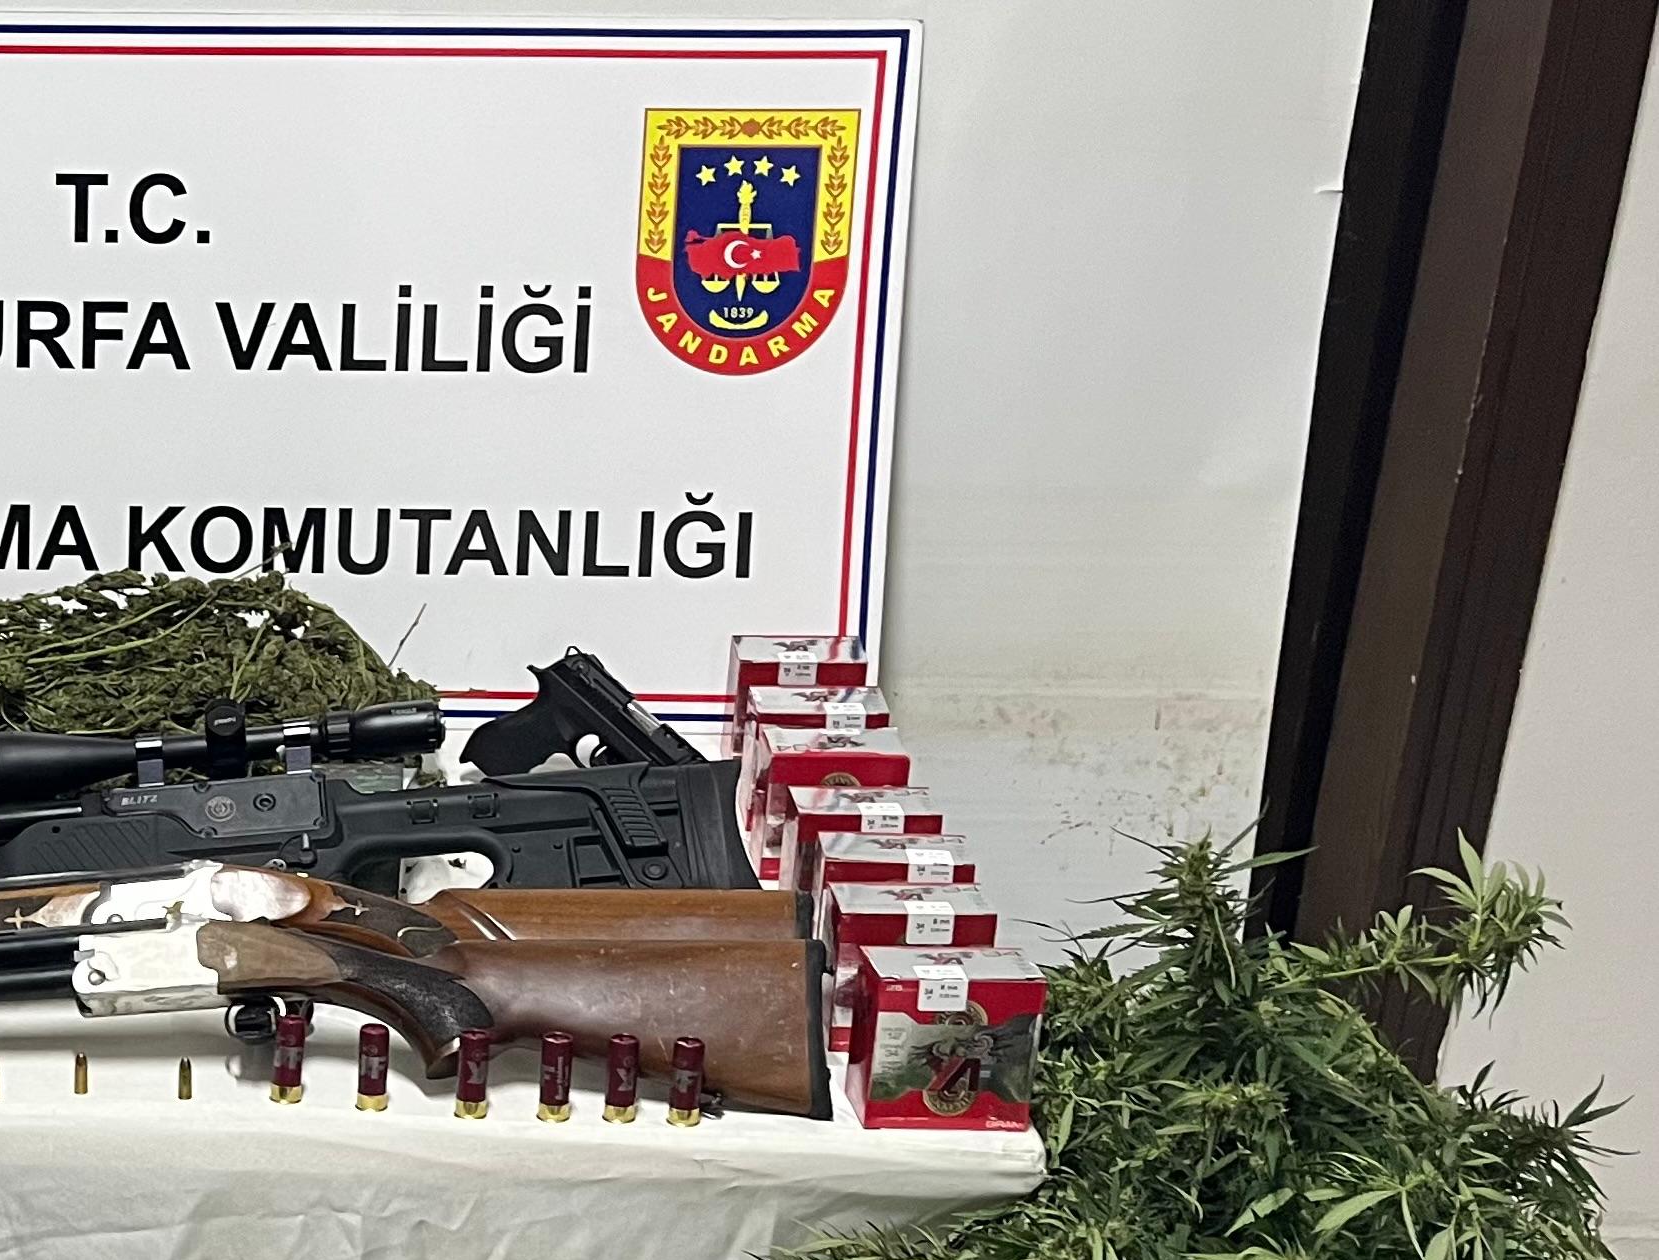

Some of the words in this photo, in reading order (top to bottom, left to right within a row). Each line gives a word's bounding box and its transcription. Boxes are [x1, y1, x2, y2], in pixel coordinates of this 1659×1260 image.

[56, 174, 210, 244] T.C.
[216, 285, 591, 373] VALİLİĞİ
[647, 286, 835, 367] JANDARMA
[723, 306, 754, 319] 1839
[129, 492, 753, 579] KOMUTANLIĞI
[121, 795, 157, 806] BLITZ
